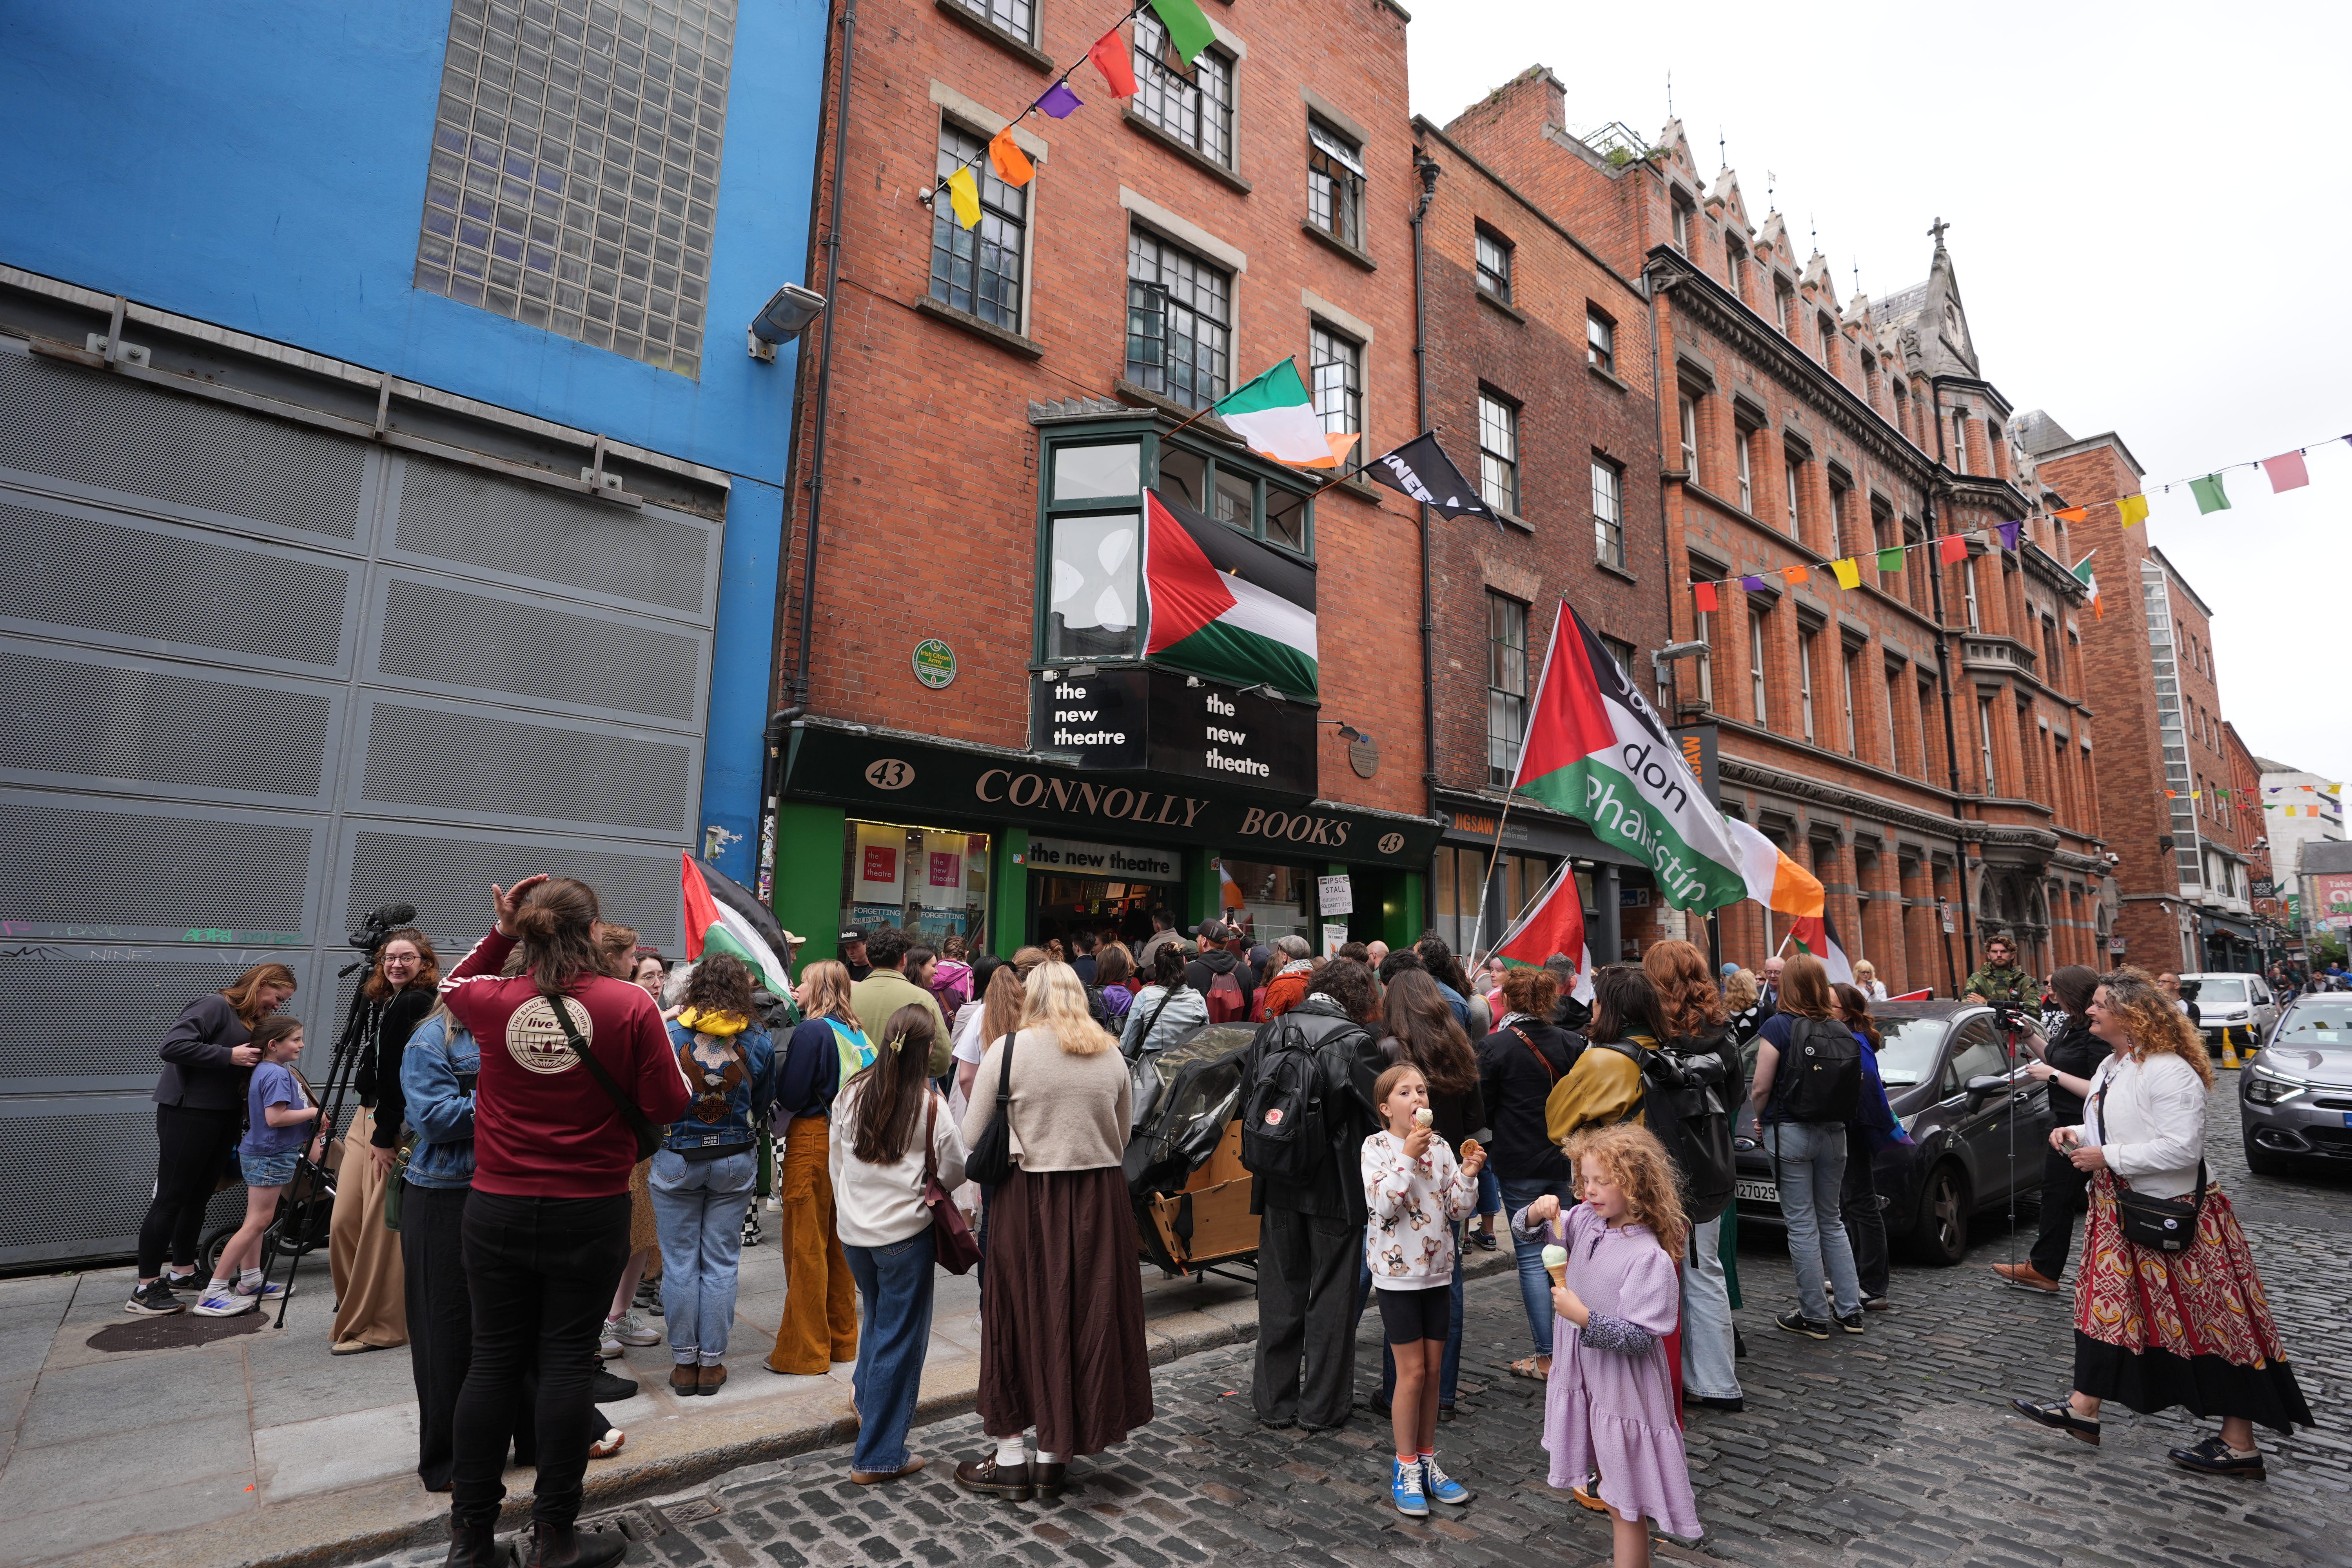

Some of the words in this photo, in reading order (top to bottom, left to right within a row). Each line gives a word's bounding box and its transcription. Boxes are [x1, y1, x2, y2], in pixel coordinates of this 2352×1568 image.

[928, 657, 942, 666] Army
[933, 653, 950, 661] Citizen
[1055, 682, 1086, 700] the
[1206, 693, 1235, 717] the
[1054, 708, 1098, 722] new
[1054, 728, 1125, 746] theatre
[1206, 726, 1246, 746] new
[1206, 748, 1270, 777] theatre
[871, 762, 904, 786] 43
[1623, 743, 1687, 814] don
[1740, 768, 1776, 789] DOLPHIN
[1773, 777, 1797, 793] HOTEL
[975, 768, 1210, 828] CONNOLLY
[1238, 807, 1352, 847] BOOKS
[1379, 833, 1403, 853] 43
[1454, 812, 1495, 835] JIGSAW
[868, 851, 879, 860] the
[933, 857, 944, 866] the
[1031, 842, 1060, 864] the
[1066, 852, 1105, 867] new
[1110, 851, 1170, 874] theatre
[867, 869, 892, 878] theatre
[933, 875, 956, 883] theatre
[1639, 891, 1647, 904] 2
[853, 906, 901, 916] FORGETTING
[920, 911, 965, 920] FORGETTING
[91, 949, 152, 960] NINE
[512, 1015, 522, 1028] THE
[521, 1002, 539, 1015] BAND
[575, 1009, 588, 1034] STRIPES
[527, 1018, 554, 1029] live
[1736, 1183, 1775, 1200] 127029
